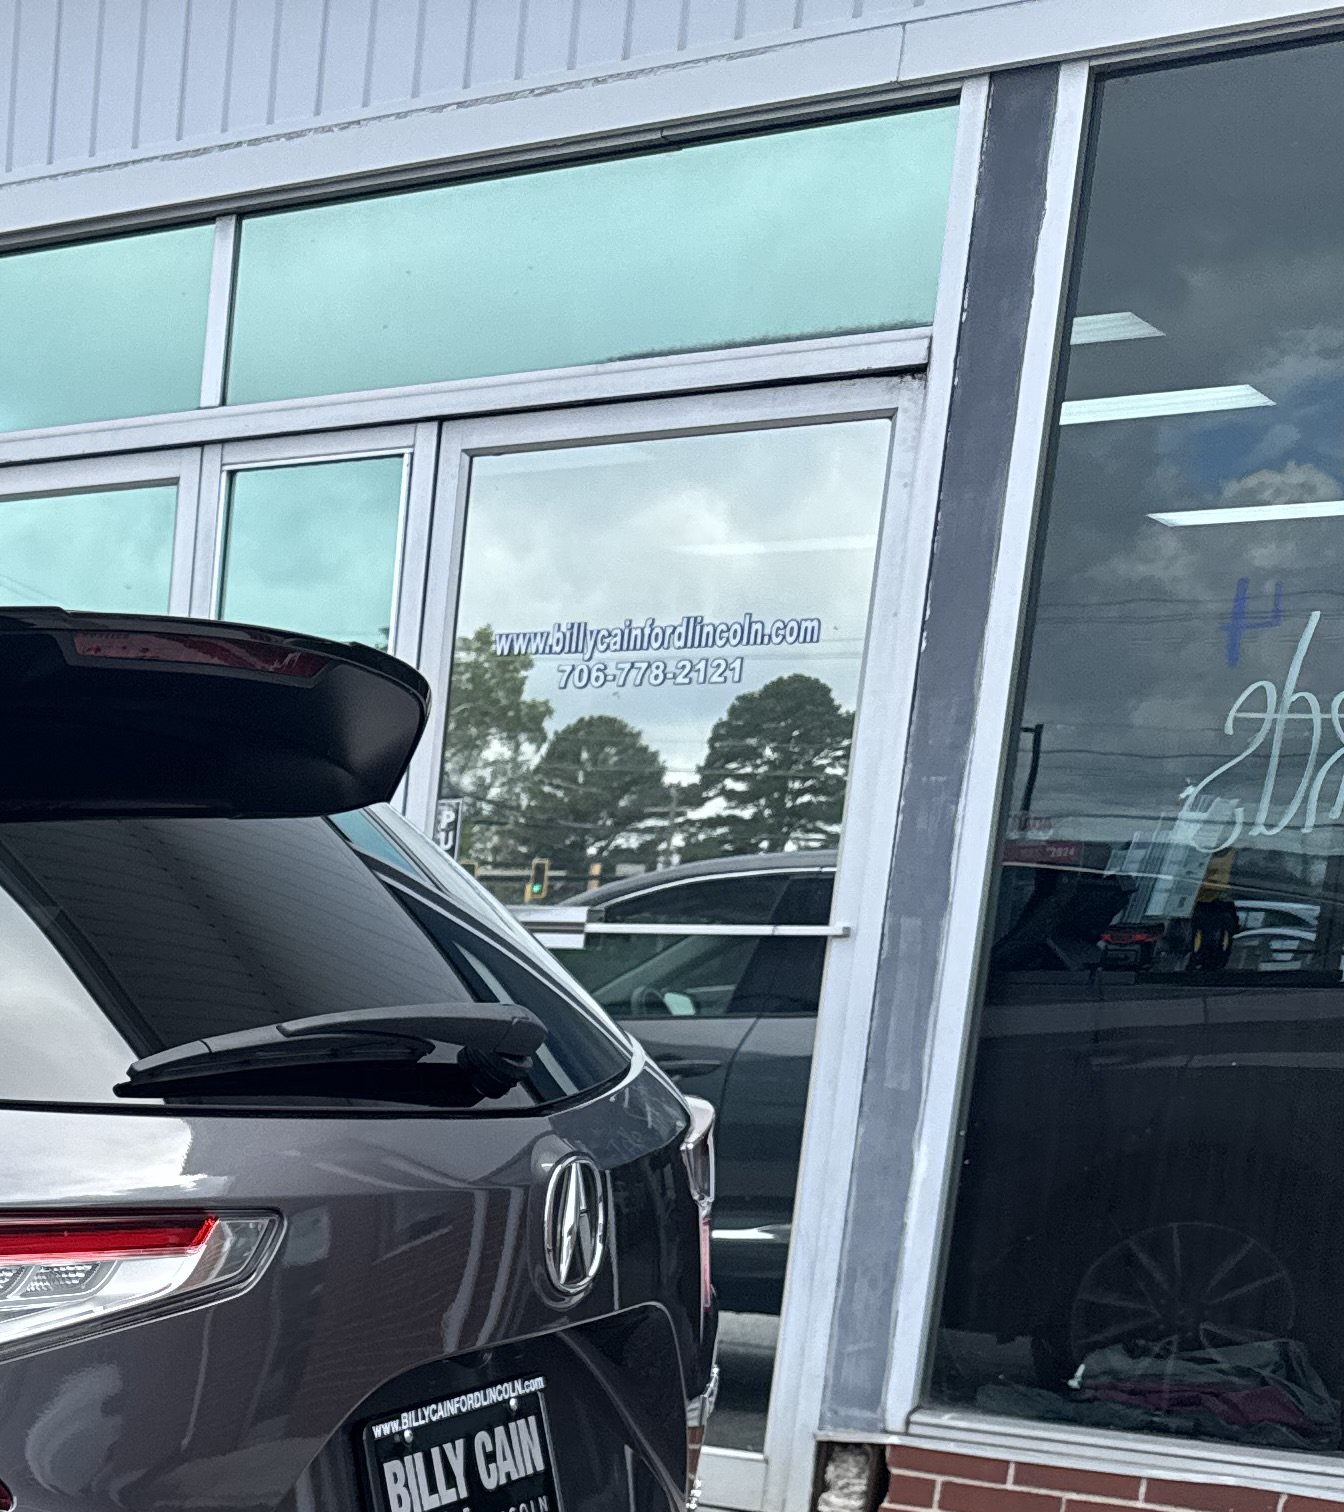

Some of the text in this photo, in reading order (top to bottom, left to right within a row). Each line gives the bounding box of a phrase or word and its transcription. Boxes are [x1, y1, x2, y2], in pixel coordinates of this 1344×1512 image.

[495, 613, 821, 661] www.billycainfordlincoln.com
[557, 657, 744, 689] 706-778-2121
[372, 1376, 545, 1440] www.BILLYCAINFORDLINCOLN.com
[474, 1415, 545, 1490] CAIN
